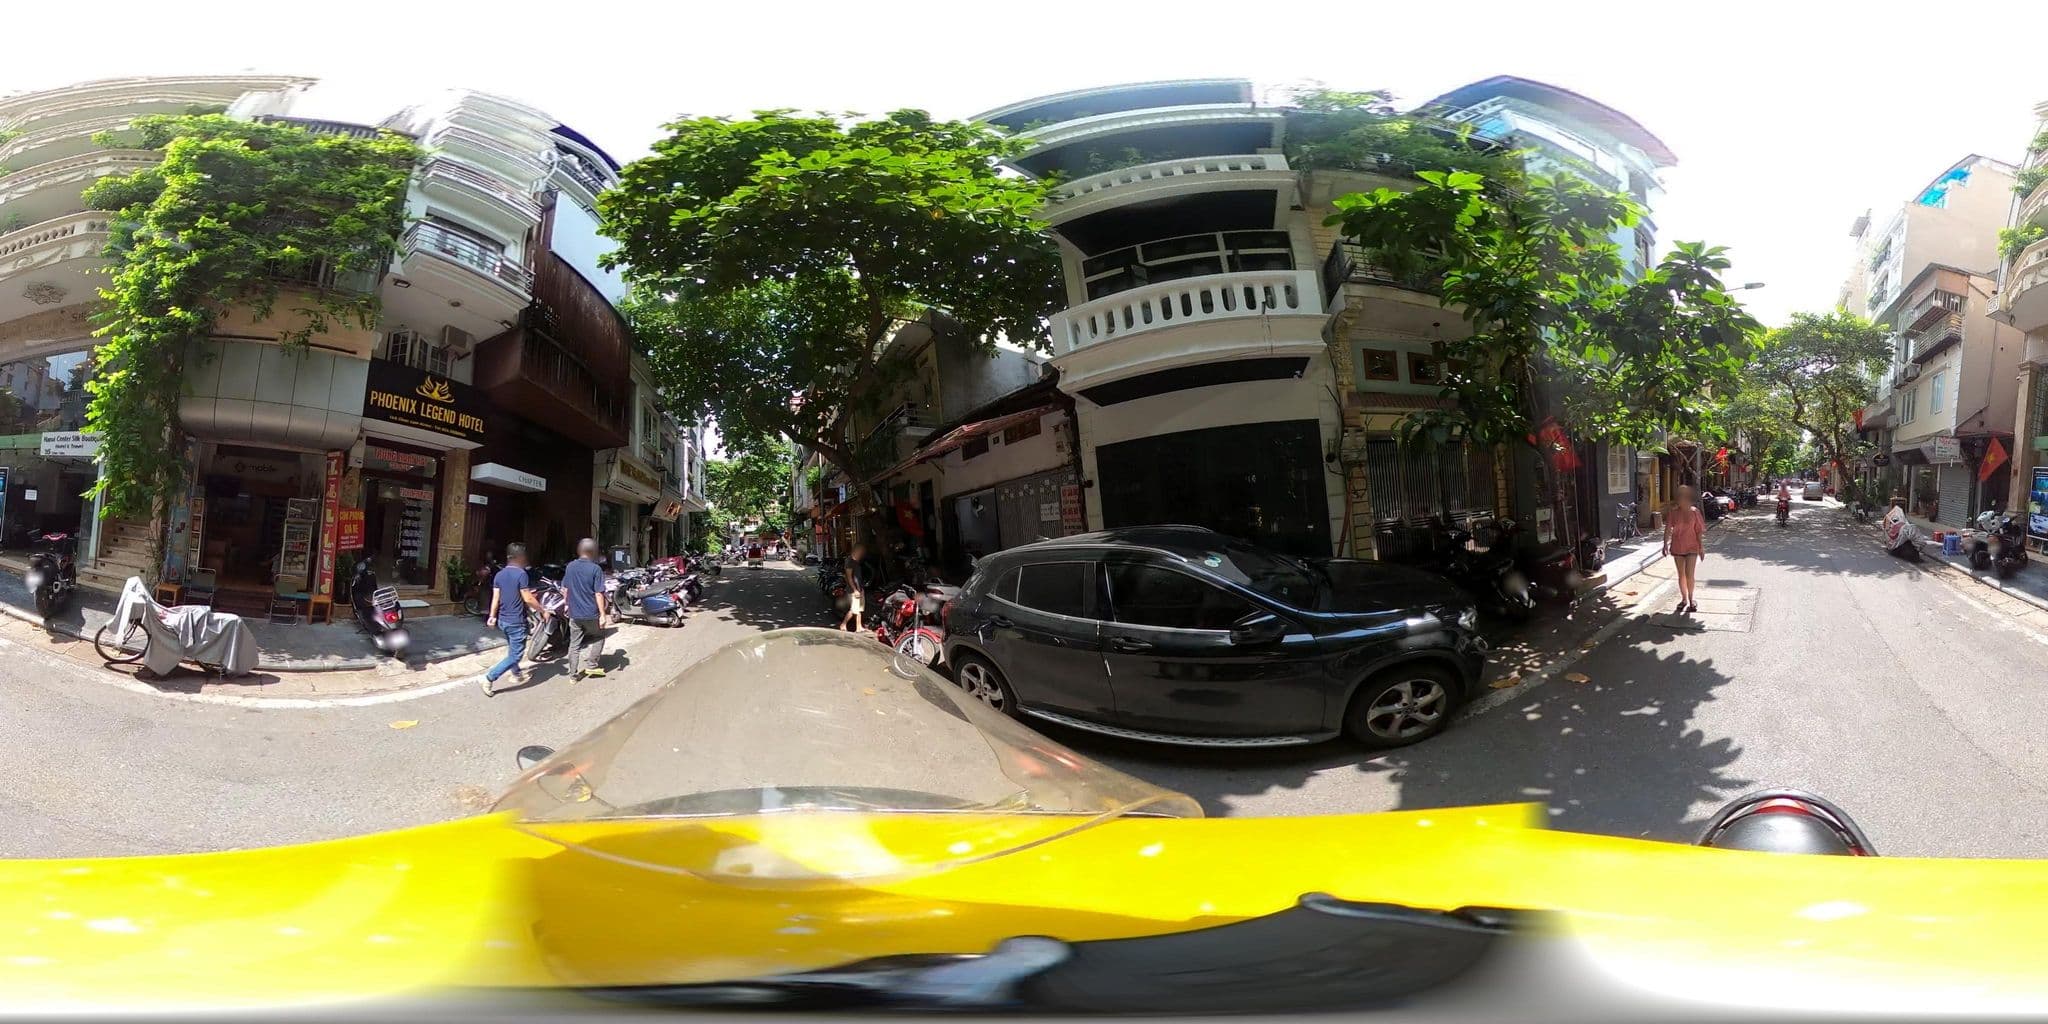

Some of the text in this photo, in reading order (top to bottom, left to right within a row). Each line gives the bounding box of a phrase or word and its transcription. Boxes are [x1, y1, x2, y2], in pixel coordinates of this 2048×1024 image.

[370, 390, 417, 414] PHOENIX
[420, 402, 456, 424] LEGEND
[458, 413, 484, 433] HOTEL
